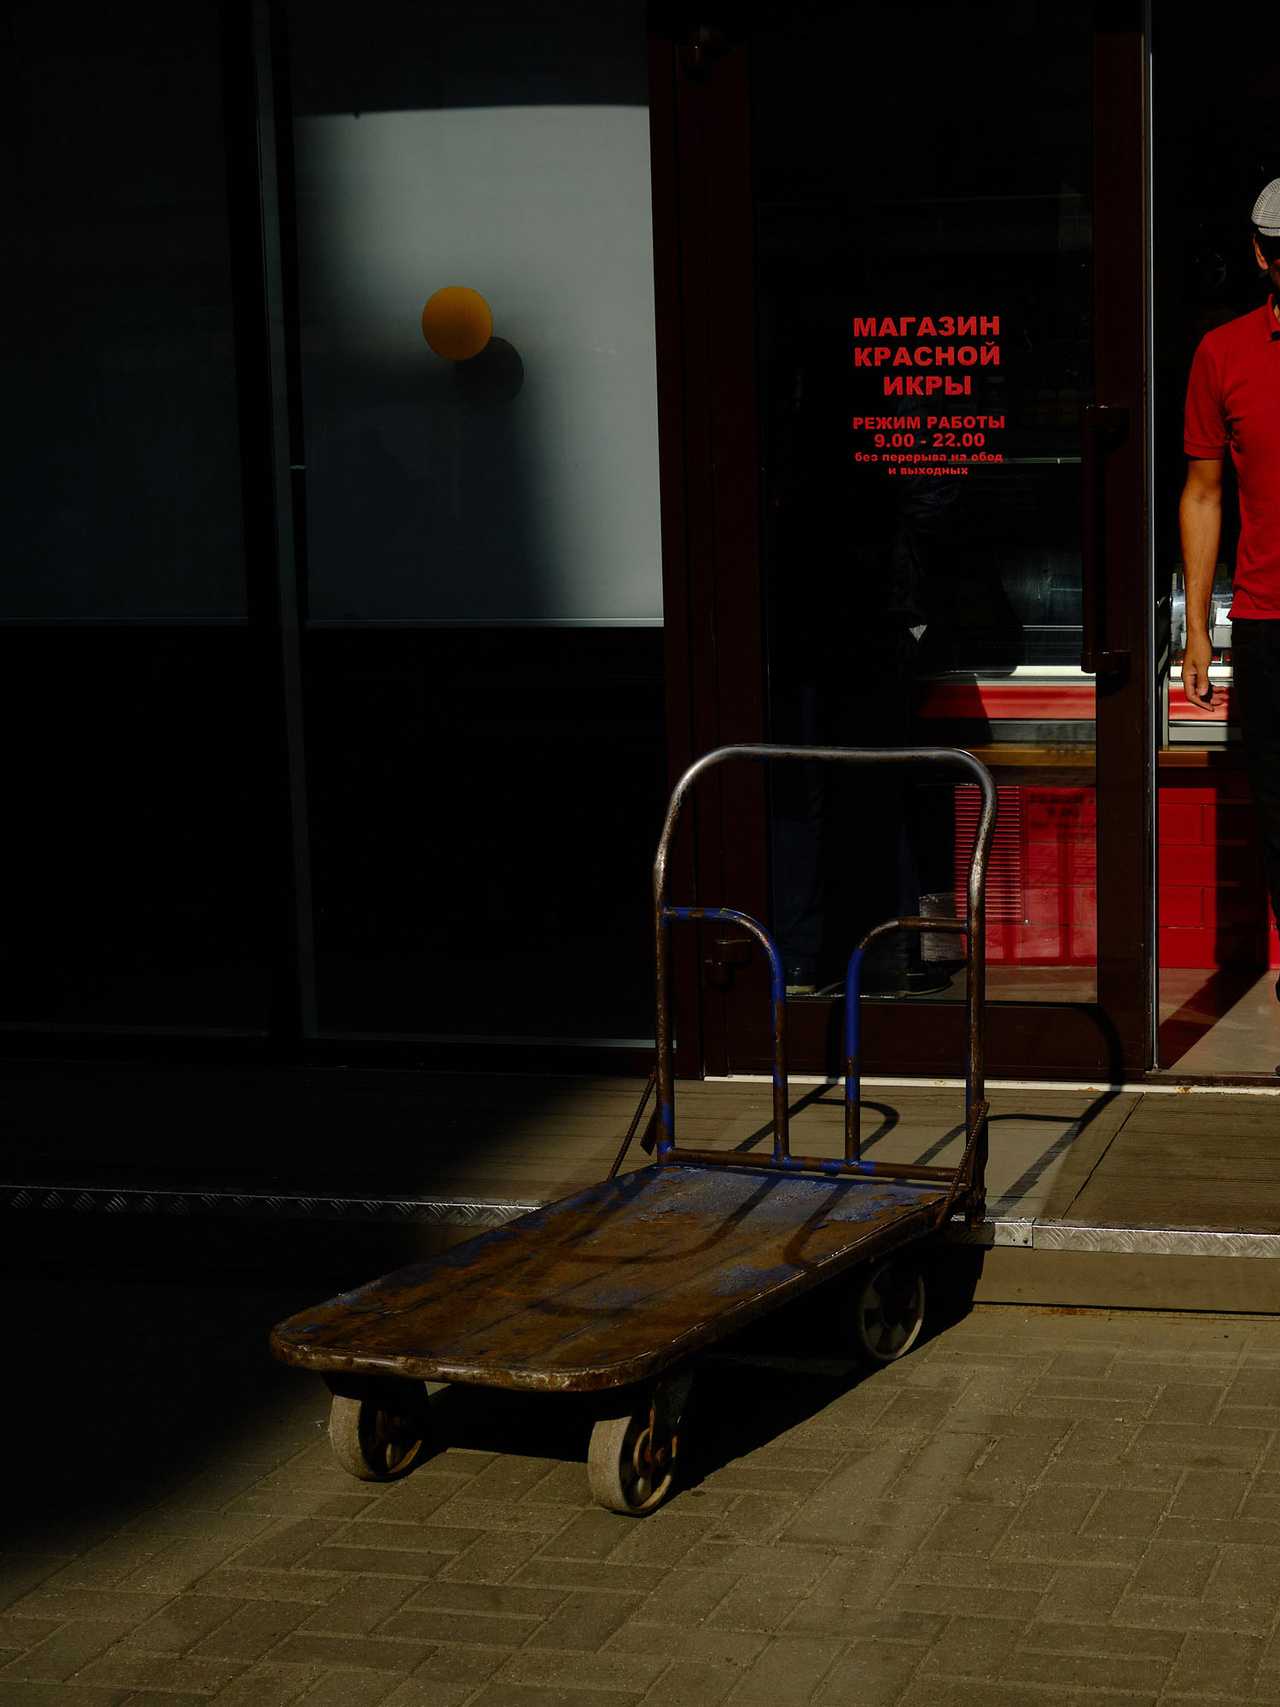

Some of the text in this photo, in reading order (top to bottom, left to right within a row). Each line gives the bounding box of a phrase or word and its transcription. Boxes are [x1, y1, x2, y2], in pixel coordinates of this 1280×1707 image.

[853, 315, 1000, 338] МАГАЗИН
[854, 340, 1001, 367] КРАСНОЙ
[883, 375, 972, 396] ИКРЫ
[852, 415, 1006, 430] РЕЖИМ РАБОТЫ
[874, 433, 915, 448] 9.00
[932, 432, 986, 447] 22.00
[854, 451, 1003, 464] без перерыва на обед
[888, 466, 969, 476] и выходных
